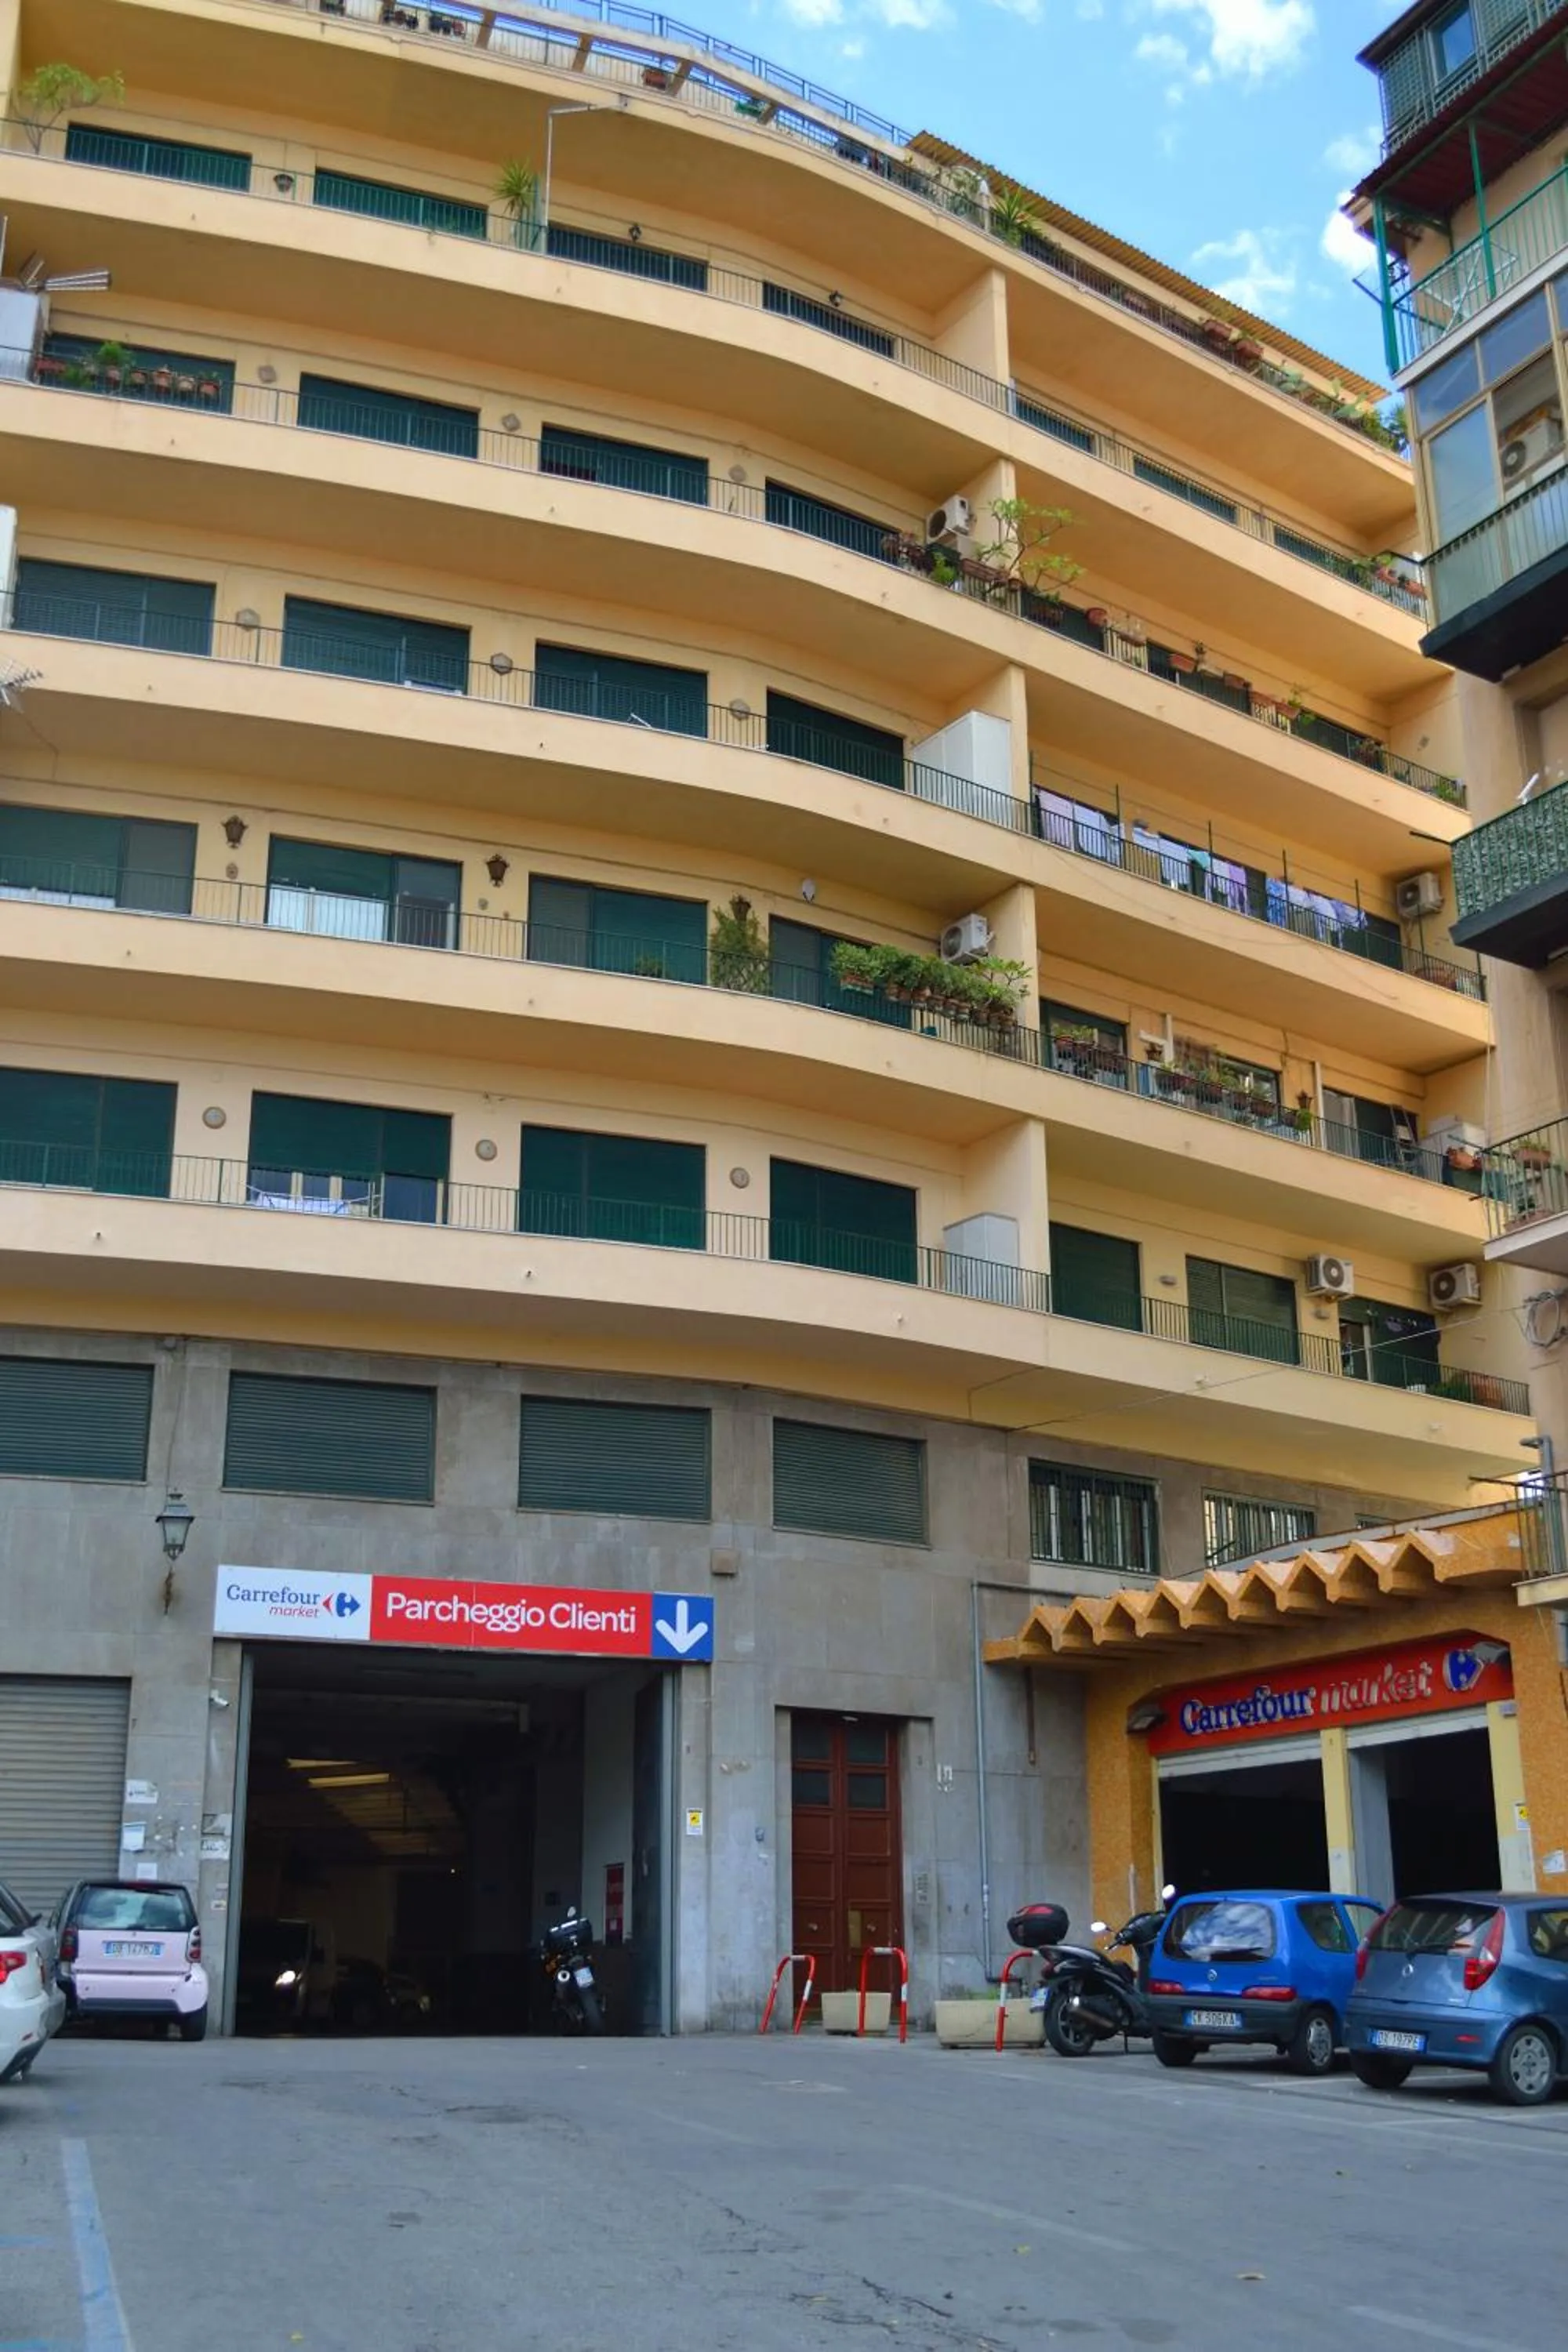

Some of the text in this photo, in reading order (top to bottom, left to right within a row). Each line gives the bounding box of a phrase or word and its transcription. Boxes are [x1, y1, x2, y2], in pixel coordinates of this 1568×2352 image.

[227, 1584, 321, 1605] Carrefour
[269, 1606, 320, 1618] market
[387, 1592, 637, 1633] Parcheggio Clienti
[1181, 1662, 1432, 1735] Carrefour market
